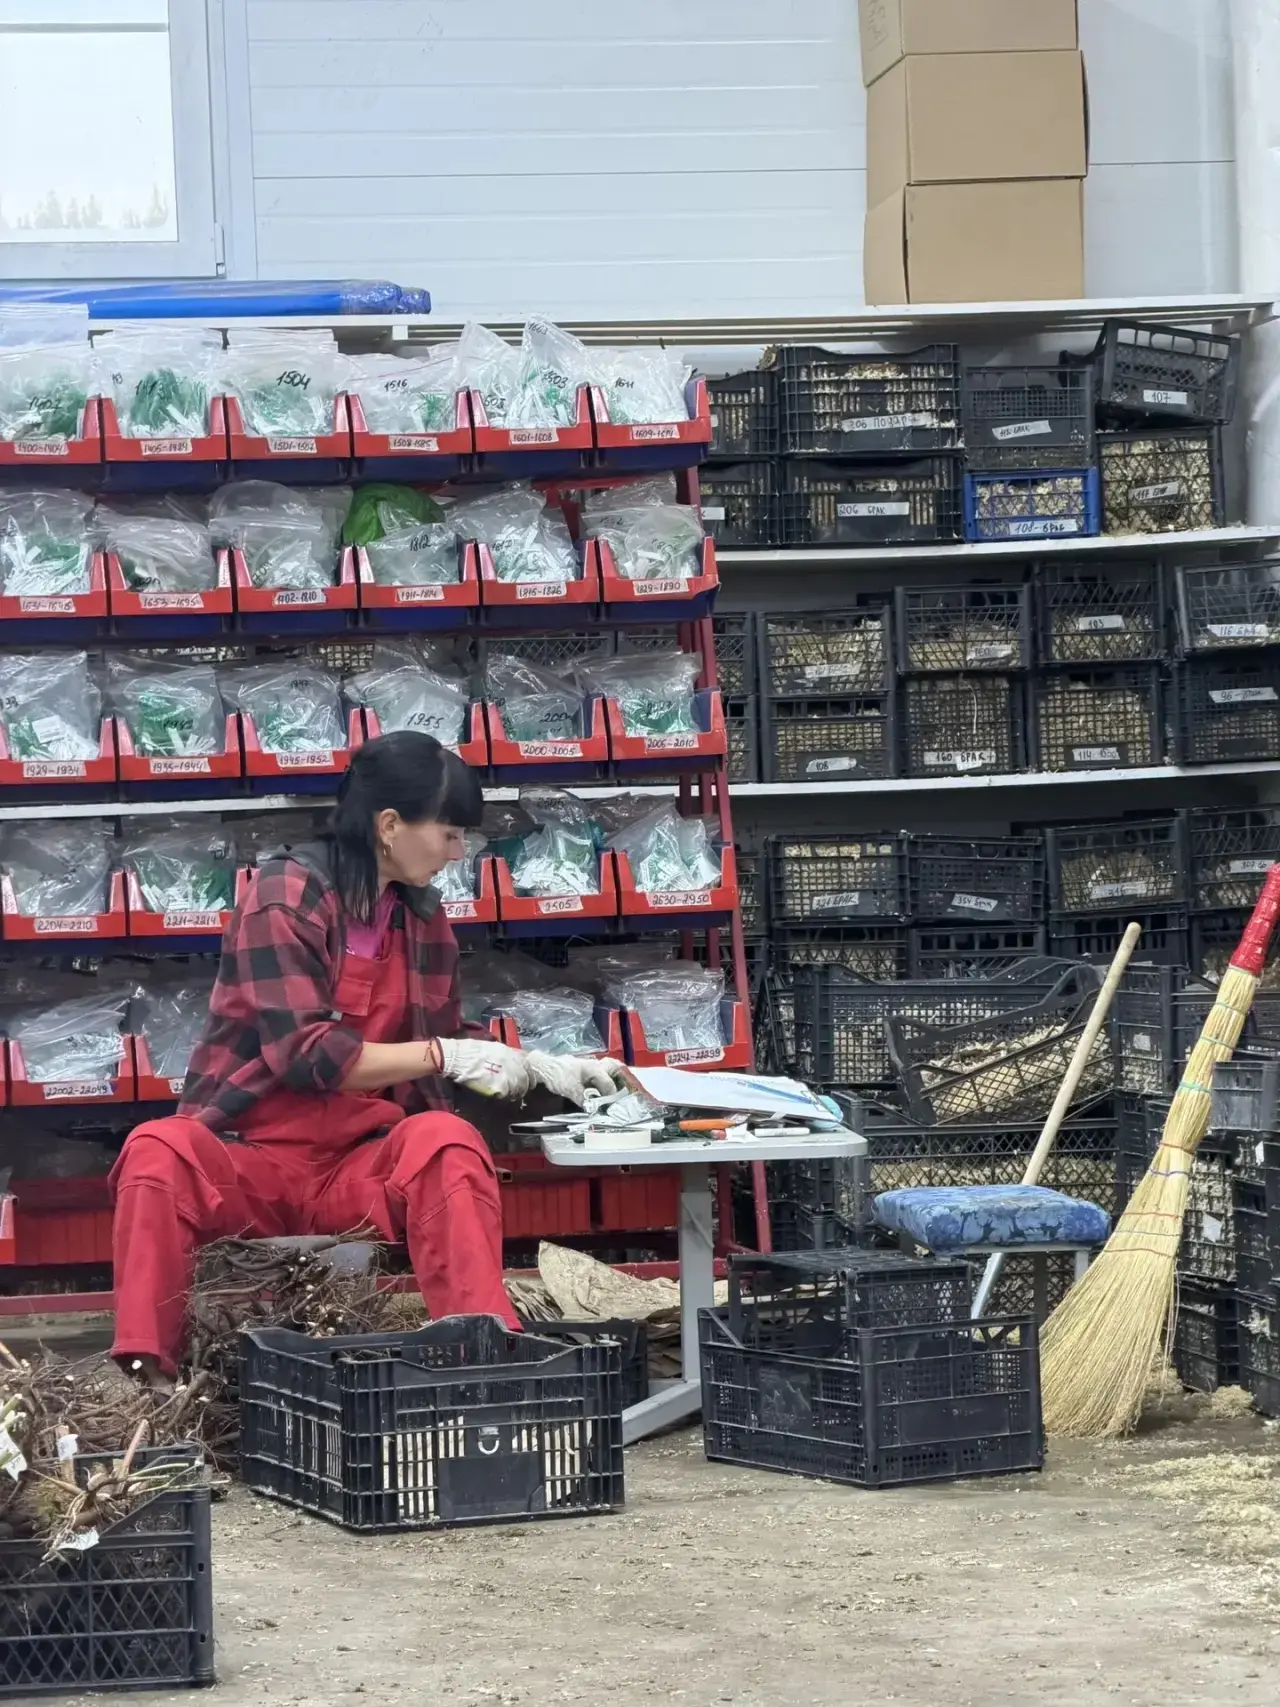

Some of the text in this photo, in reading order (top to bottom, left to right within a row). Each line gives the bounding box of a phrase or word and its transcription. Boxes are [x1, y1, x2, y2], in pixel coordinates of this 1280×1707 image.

[276, 370, 312, 391] 1504
[384, 379, 408, 392] 1516
[1151, 392, 1171, 404] 107
[409, 534, 438, 552] 1812
[636, 581, 681, 594] 1829-1890
[1219, 626, 1232, 637] 116
[407, 712, 444, 730] 1955
[647, 738, 694, 748] 2006-2010
[523, 743, 577, 756] 2000-2005
[279, 754, 330, 766] 1945-1952
[26, 764, 80, 777] 1929-1934
[153, 761, 203, 773] 1935-1944
[545, 899, 573, 911] 2505
[37, 920, 93, 931] 2204-2210
